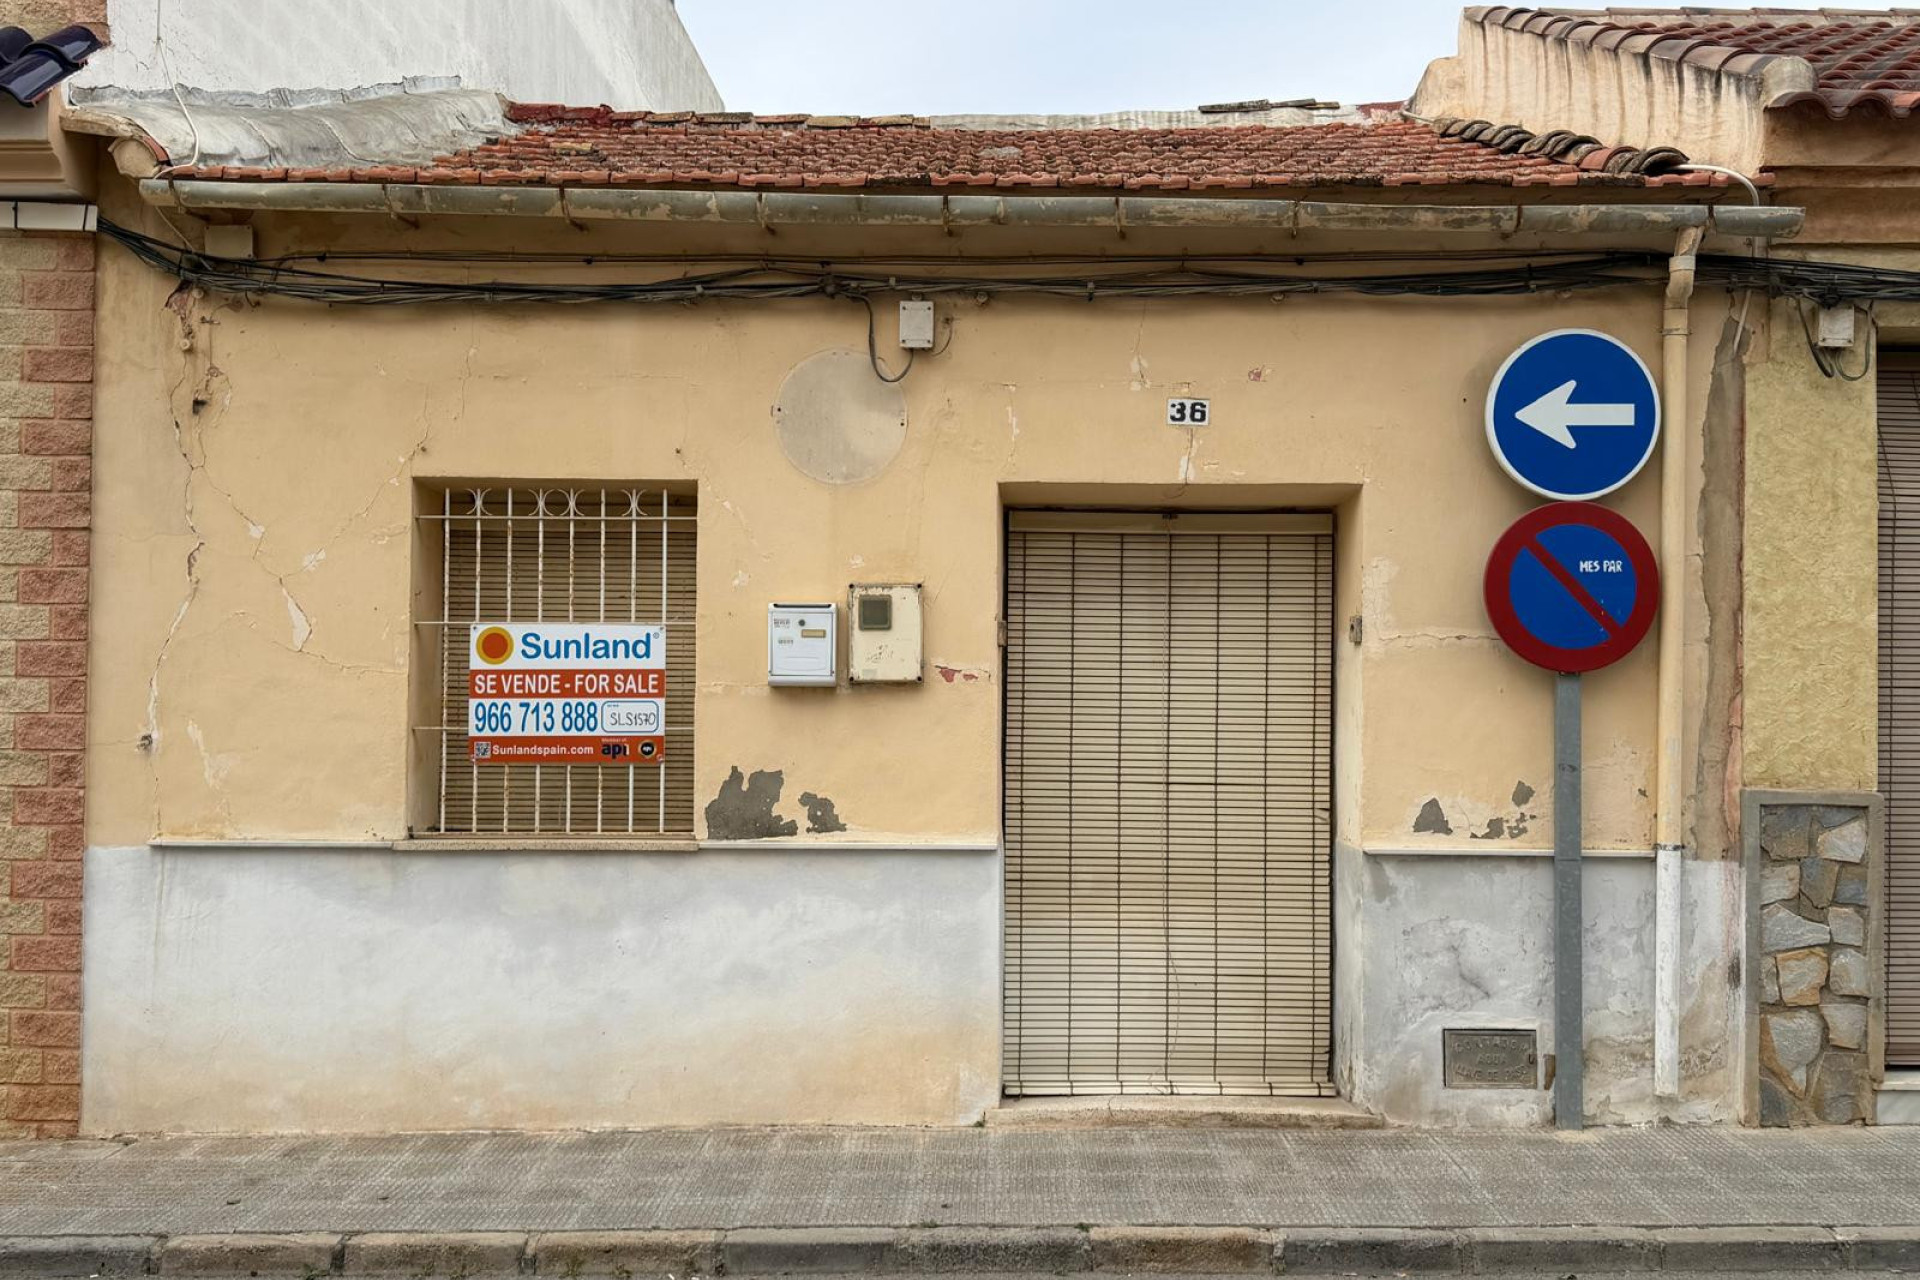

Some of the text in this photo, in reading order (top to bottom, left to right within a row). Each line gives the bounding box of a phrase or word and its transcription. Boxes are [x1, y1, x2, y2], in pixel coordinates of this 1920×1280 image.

[1170, 401, 1207, 422] 36
[1579, 560, 1623, 573] MES PAR
[474, 674, 497, 694] SE
[501, 674, 561, 694] VENDE
[575, 674, 609, 694] FOR
[614, 674, 659, 694] SALE
[474, 701, 598, 733] 966 713 888
[610, 711, 656, 726] SLS1570
[492, 744, 594, 760] Sunlandspain.com
